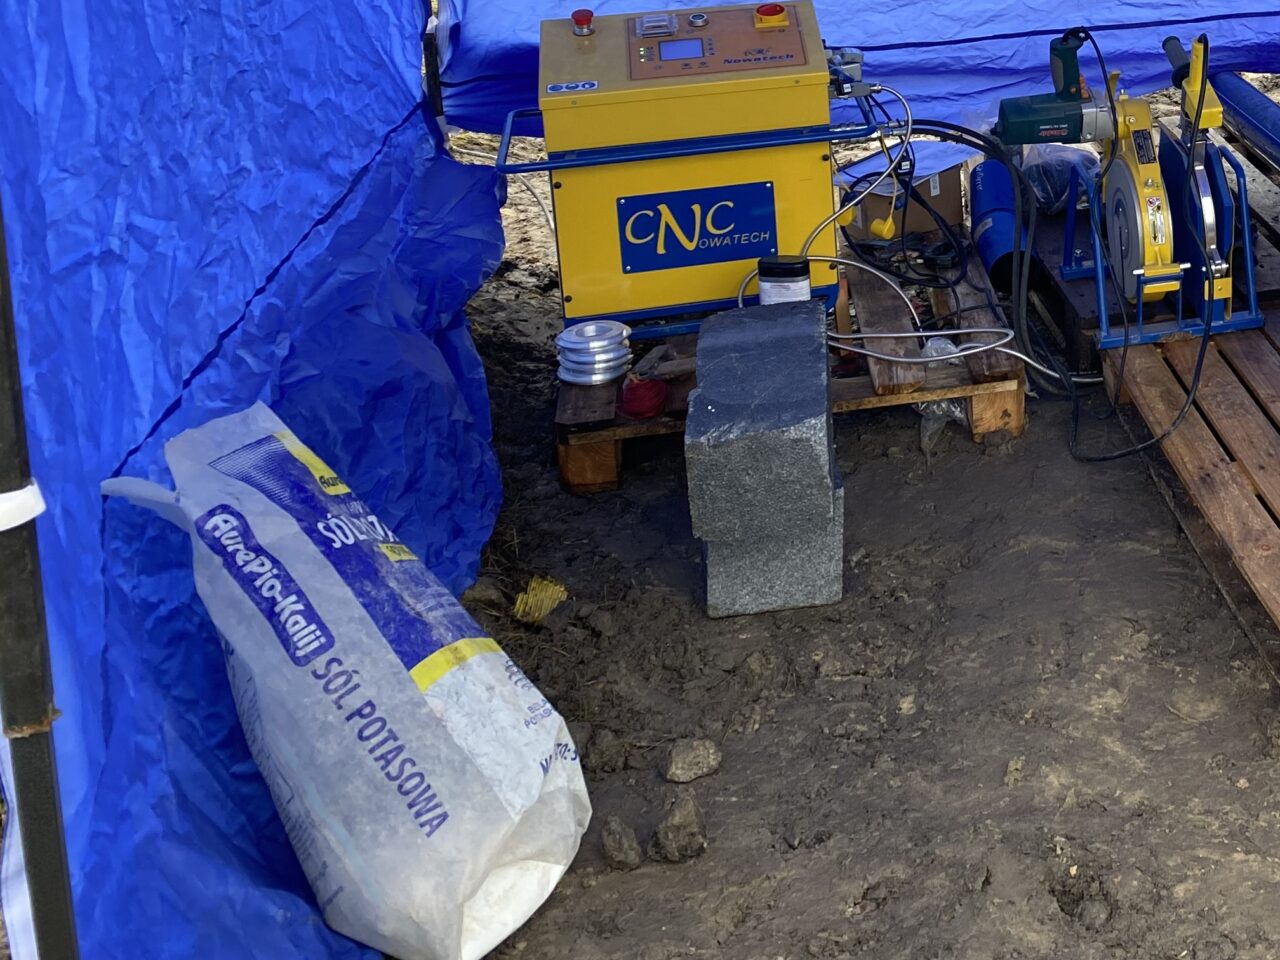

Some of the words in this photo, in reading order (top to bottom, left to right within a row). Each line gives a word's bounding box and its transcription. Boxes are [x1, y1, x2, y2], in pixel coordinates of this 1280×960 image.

[723, 53, 795, 65] Nowatech
[625, 201, 735, 254] CNC
[203, 512, 327, 658] AurePio-Kalij
[345, 699, 449, 838] POTASOWA
